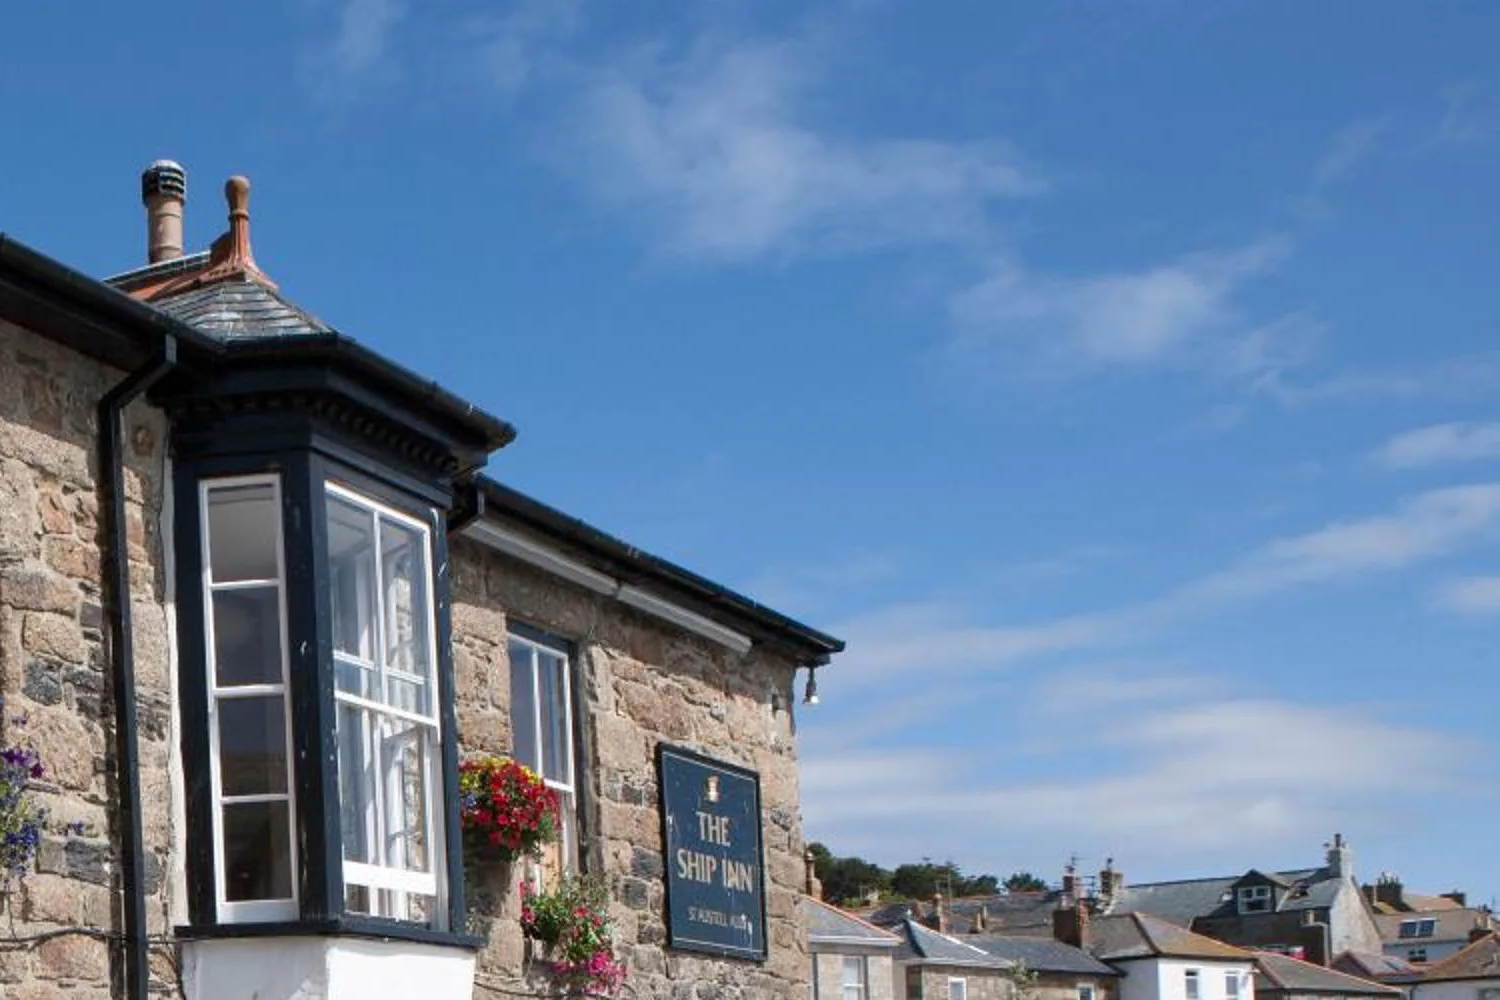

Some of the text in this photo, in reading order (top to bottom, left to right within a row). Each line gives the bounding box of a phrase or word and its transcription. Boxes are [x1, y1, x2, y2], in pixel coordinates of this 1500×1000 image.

[695, 811, 732, 847] THE
[676, 848, 753, 894] SHIP INN
